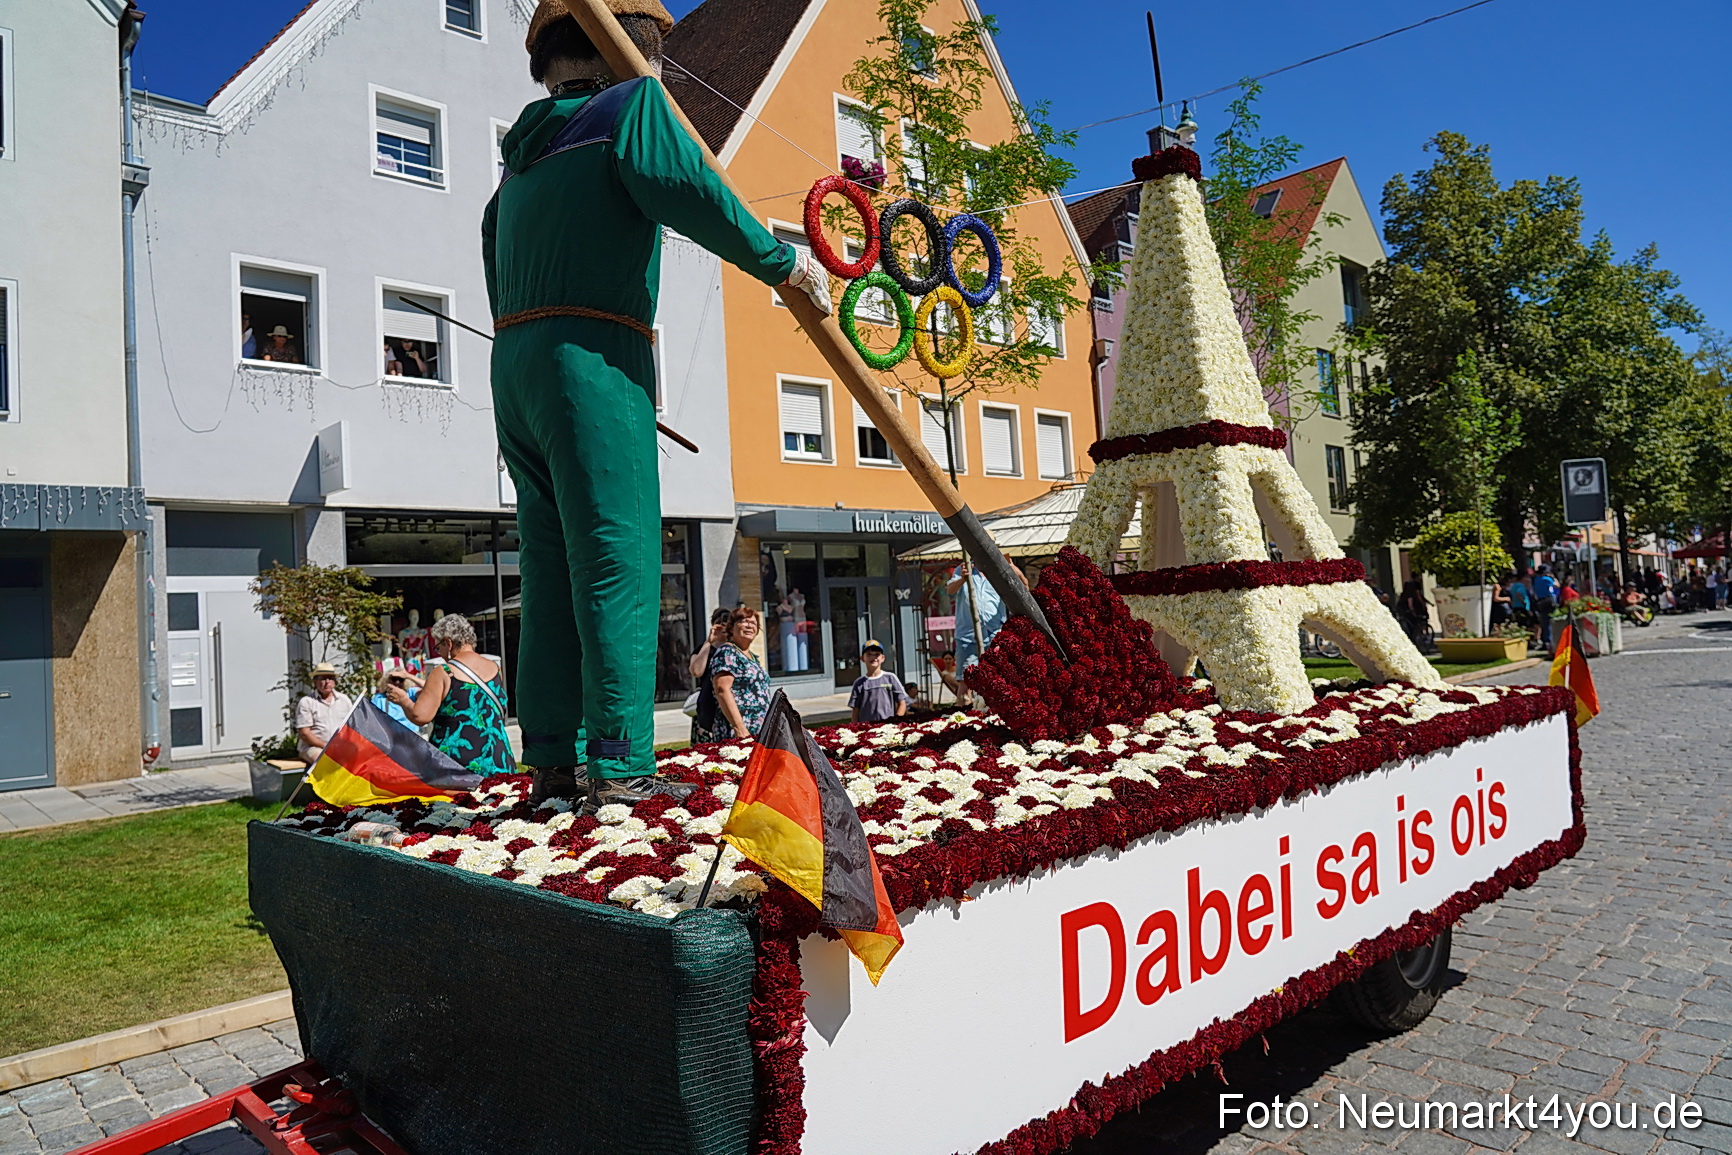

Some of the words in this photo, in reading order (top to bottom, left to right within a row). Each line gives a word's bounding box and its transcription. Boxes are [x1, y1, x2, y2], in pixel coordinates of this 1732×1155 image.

[855, 512, 944, 534] hunkemöller
[1061, 835, 1292, 1044] Dabei
[1316, 831, 1380, 920] sa
[1396, 795, 1435, 884] is
[1451, 767, 1508, 857] ois
